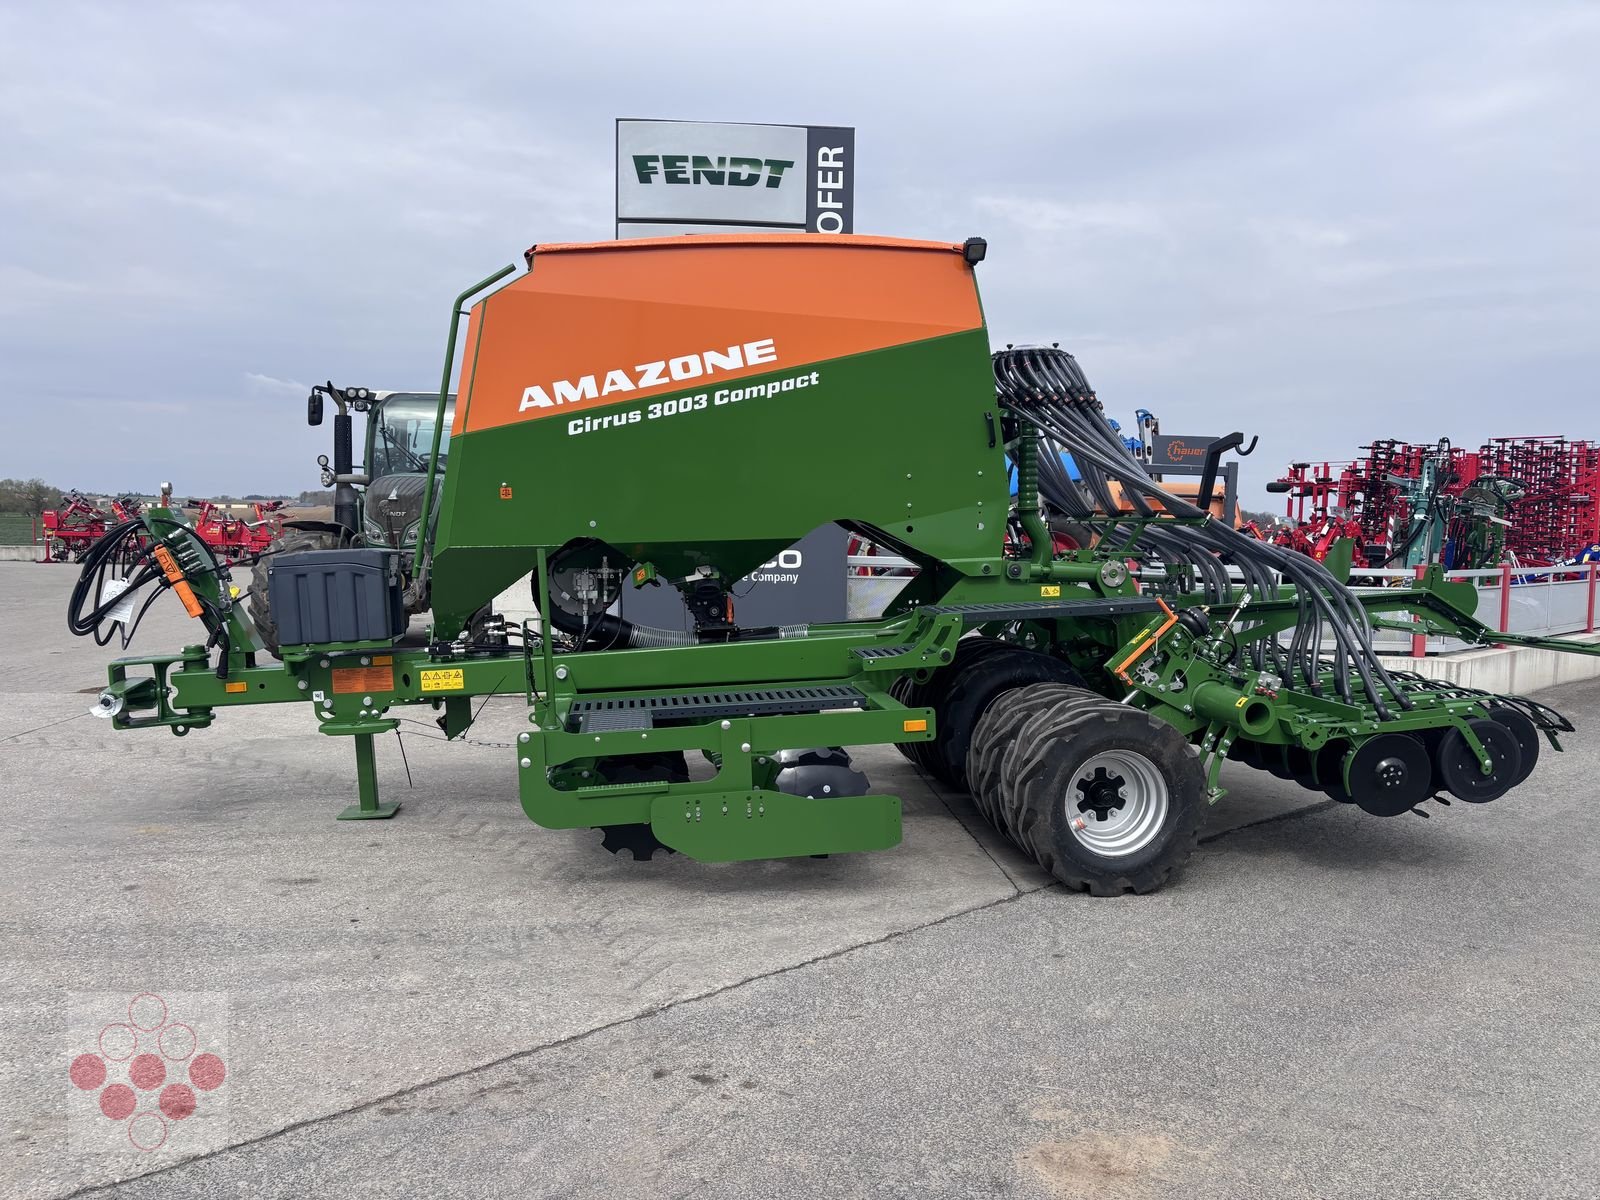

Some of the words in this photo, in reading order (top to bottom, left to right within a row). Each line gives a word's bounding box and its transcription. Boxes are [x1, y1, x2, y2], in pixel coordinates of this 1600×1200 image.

[632, 154, 795, 189] FENDT
[518, 338, 778, 412] AMAZONE
[567, 409, 642, 436] Cirrus
[647, 394, 708, 419] 3003
[714, 371, 820, 406] Compact
[1173, 444, 1206, 456] hauer
[751, 571, 799, 584] Company
